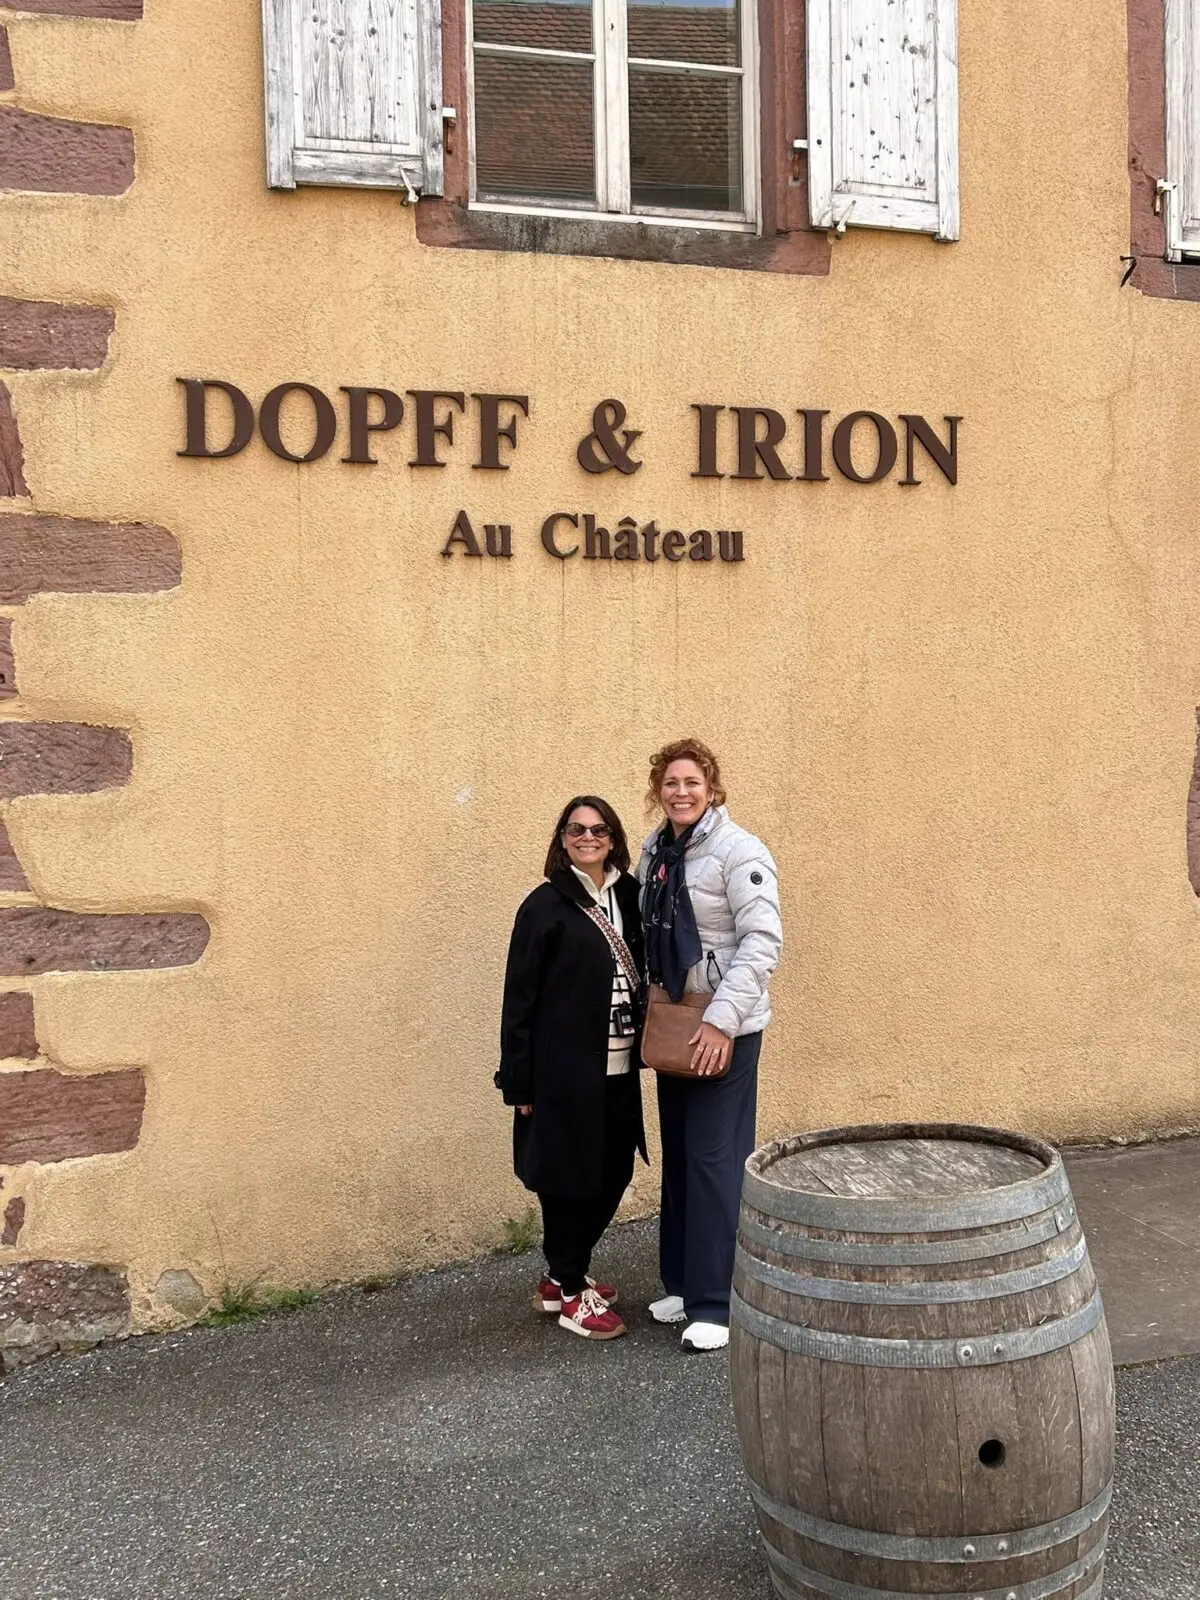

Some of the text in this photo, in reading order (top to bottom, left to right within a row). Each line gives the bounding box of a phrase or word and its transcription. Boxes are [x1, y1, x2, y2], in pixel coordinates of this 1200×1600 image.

[176, 377, 964, 487] DOPFF & IRION
[440, 509, 746, 564] Au Château
